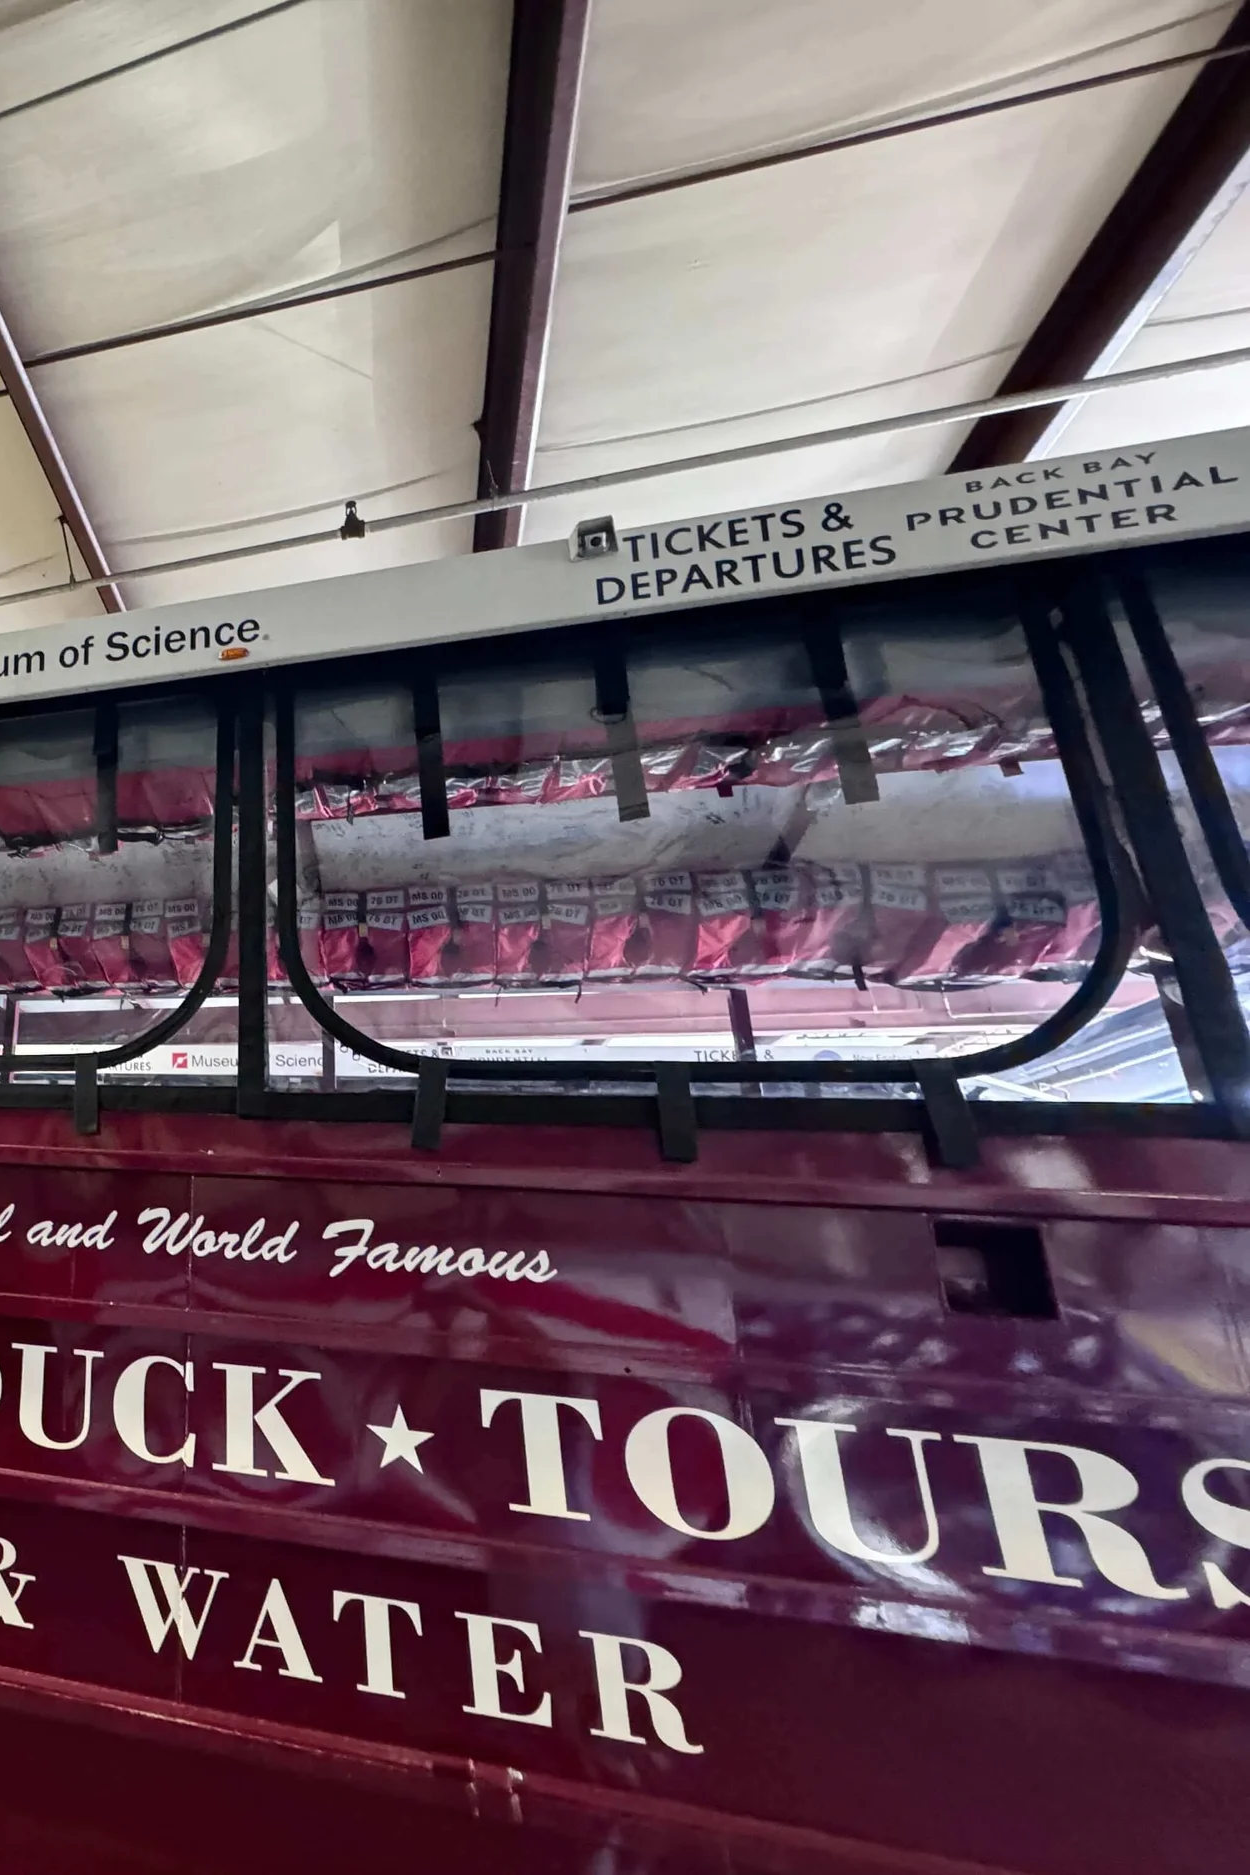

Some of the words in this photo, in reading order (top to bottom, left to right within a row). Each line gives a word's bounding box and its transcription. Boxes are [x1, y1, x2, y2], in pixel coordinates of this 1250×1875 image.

[906, 465, 1240, 532] PRUDENTIAL
[965, 466, 1062, 493] BACK
[1083, 451, 1158, 475] BAY
[622, 509, 806, 563] TICKETS
[821, 501, 854, 532] &
[970, 503, 1178, 551] CENTER
[596, 533, 898, 606] DEPARTURES
[58, 635, 95, 669] of
[104, 617, 261, 662] Science
[191, 1054, 238, 1068] Museu
[26, 1210, 118, 1251] and
[137, 1206, 300, 1264] World
[321, 1218, 558, 1284] Famous
[480, 1388, 1250, 1611] TOURS
[117, 1554, 705, 1755] WATER
